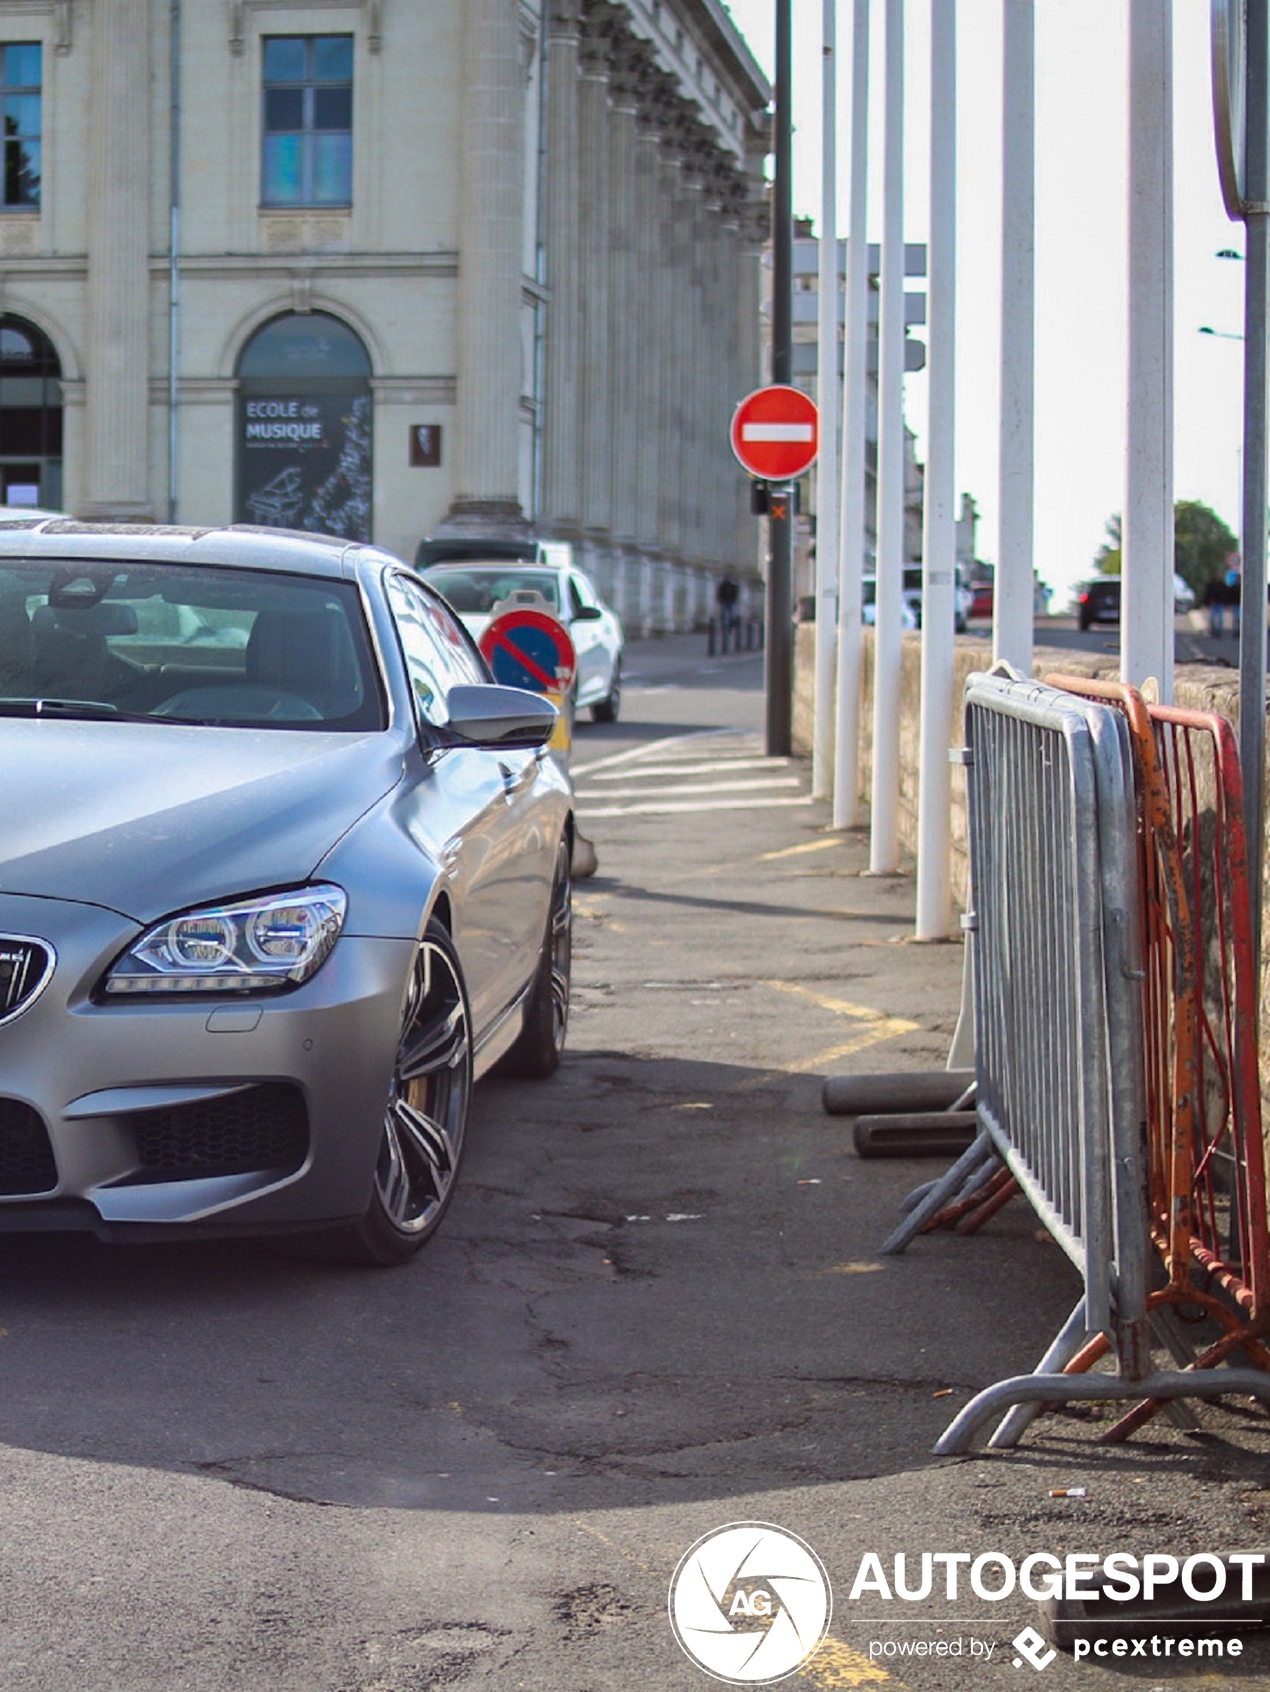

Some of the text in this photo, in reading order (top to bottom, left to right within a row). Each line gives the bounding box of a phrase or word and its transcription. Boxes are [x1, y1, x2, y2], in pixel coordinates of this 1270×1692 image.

[246, 402, 319, 418] ECOLE de
[246, 423, 321, 441] MUSIQUE
